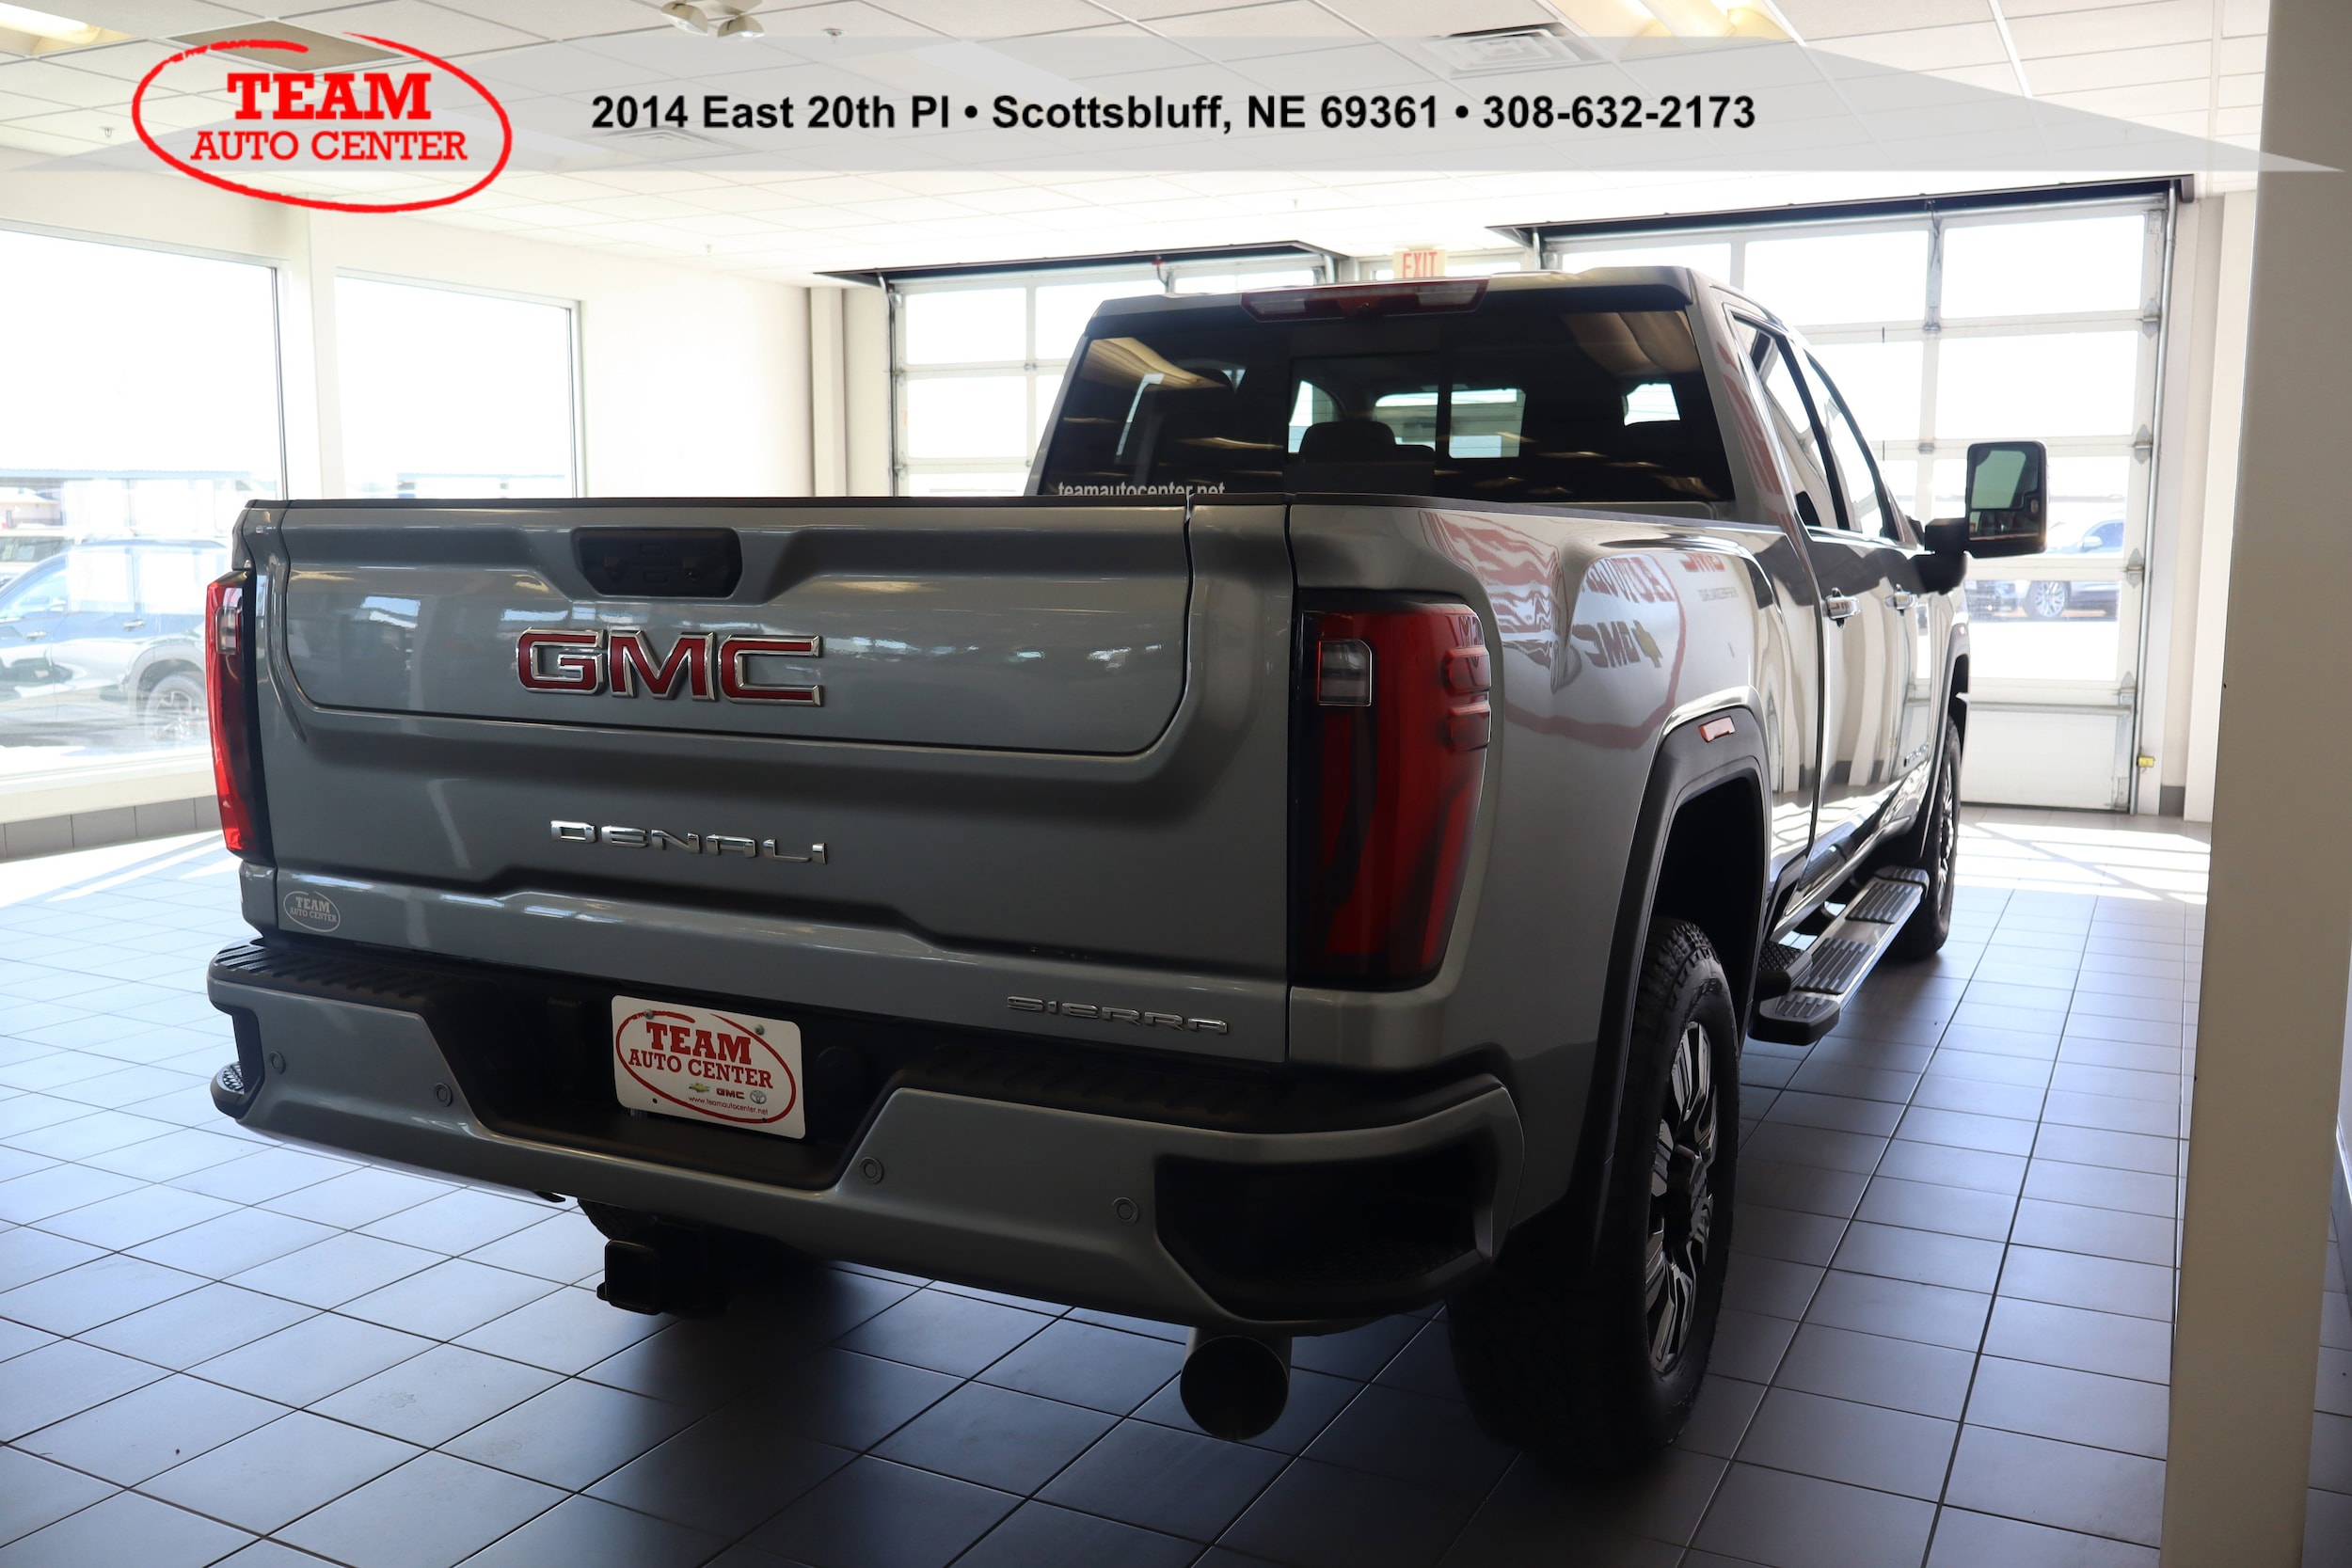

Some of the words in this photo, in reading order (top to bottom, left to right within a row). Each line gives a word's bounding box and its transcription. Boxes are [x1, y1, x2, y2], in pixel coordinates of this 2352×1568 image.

[1402, 251, 1438, 278] EXIT
[1058, 482, 1226, 496] teamautocenternet
[516, 626, 824, 706] GMC
[550, 820, 828, 864] DENALI
[290, 907, 308, 917] AUTO
[310, 911, 337, 922] CENTER
[295, 896, 330, 913] TEAM
[1007, 995, 1229, 1035] SIERRA
[645, 1022, 752, 1066] TEAM
[628, 1049, 682, 1073] AUTO
[688, 1058, 774, 1089] CENTER
[688, 1096, 770, 1117] www.teamautocenter.net
[716, 1087, 746, 1100] GMC
